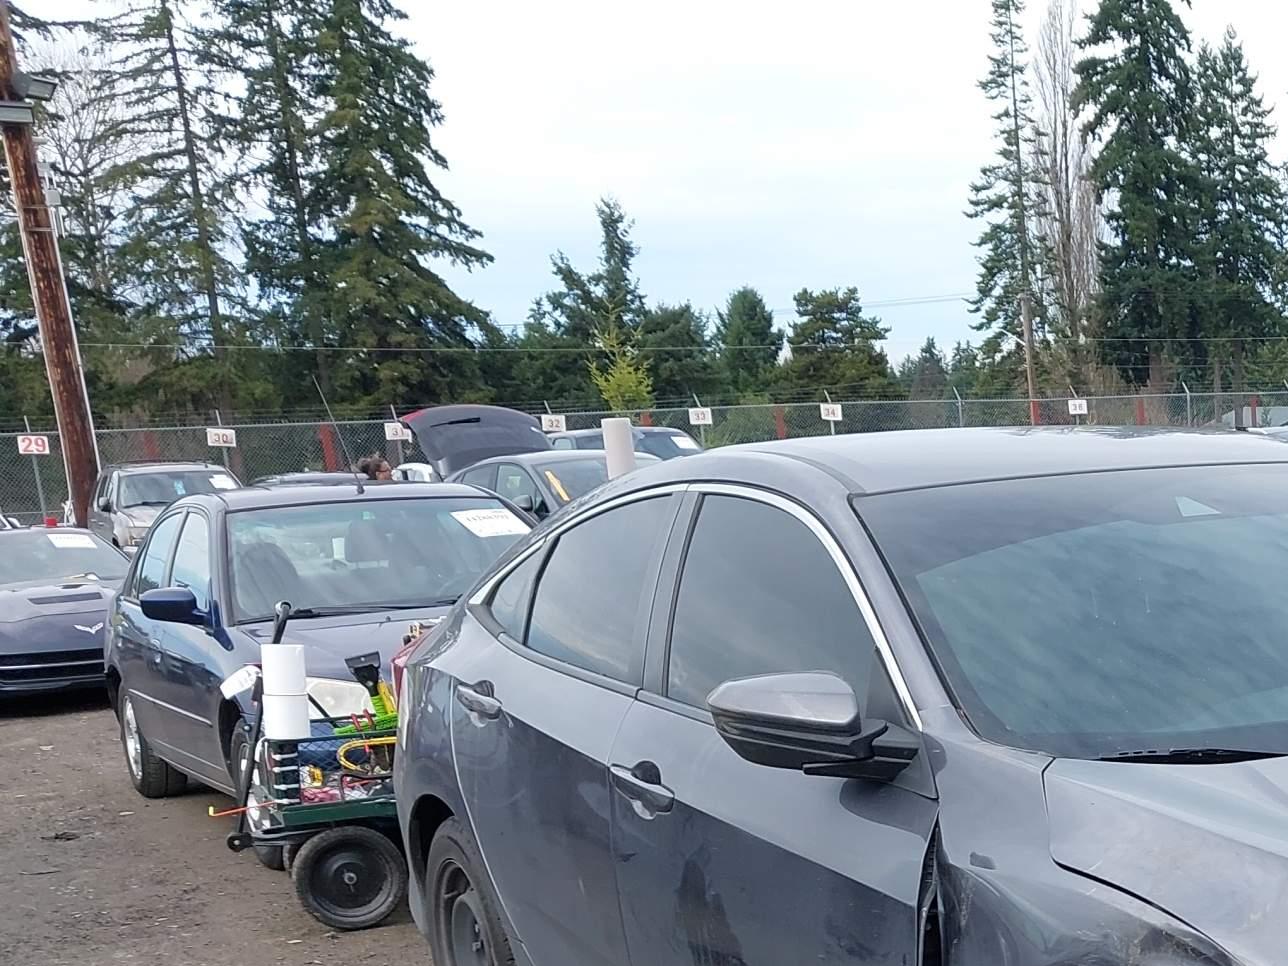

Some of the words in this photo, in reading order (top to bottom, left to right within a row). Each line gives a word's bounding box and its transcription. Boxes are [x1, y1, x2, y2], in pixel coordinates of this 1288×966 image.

[694, 412, 706, 421] 33
[825, 407, 837, 417] 34
[548, 419, 561, 428] 32
[214, 432, 229, 443] 30
[20, 437, 47, 453] 29
